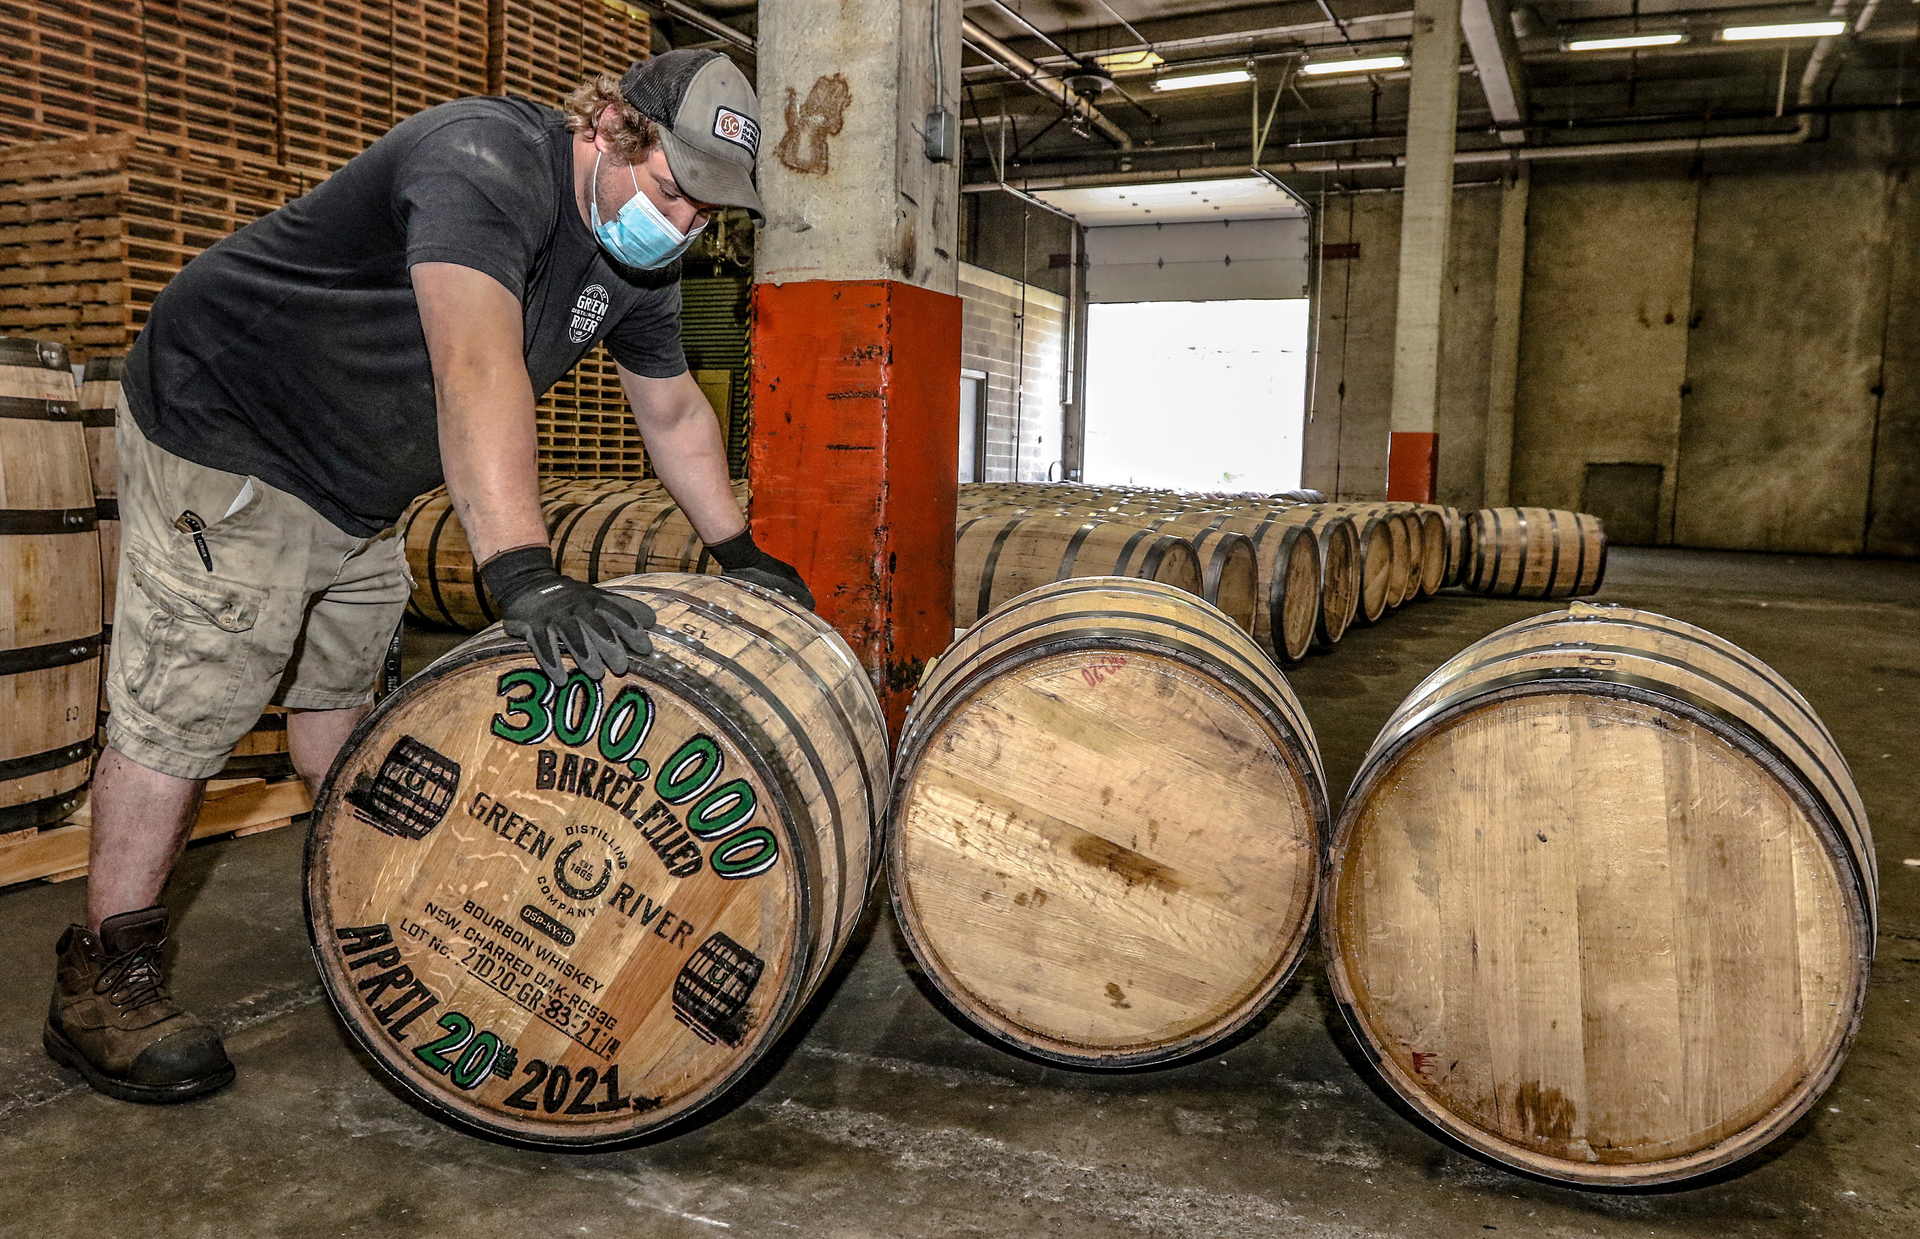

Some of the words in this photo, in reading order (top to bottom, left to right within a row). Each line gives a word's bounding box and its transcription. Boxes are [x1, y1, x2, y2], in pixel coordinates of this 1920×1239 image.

[577, 295, 609, 316] GREN
[490, 668, 780, 880] 300,000
[535, 749, 645, 819] BARREL
[632, 799, 704, 879] FILLED
[467, 791, 555, 861] GREEN
[608, 881, 695, 950] RIVER
[565, 825, 627, 869] DISTILLING
[399, 917, 430, 941] LOT
[424, 902, 461, 934] NEW,
[463, 926, 533, 977] CHARRED
[537, 876, 596, 918] COMPANY
[463, 899, 535, 952] BOURBON
[535, 945, 604, 994] WHISKEY
[336, 923, 440, 1043] APRIL
[503, 1058, 631, 1115] 2021
